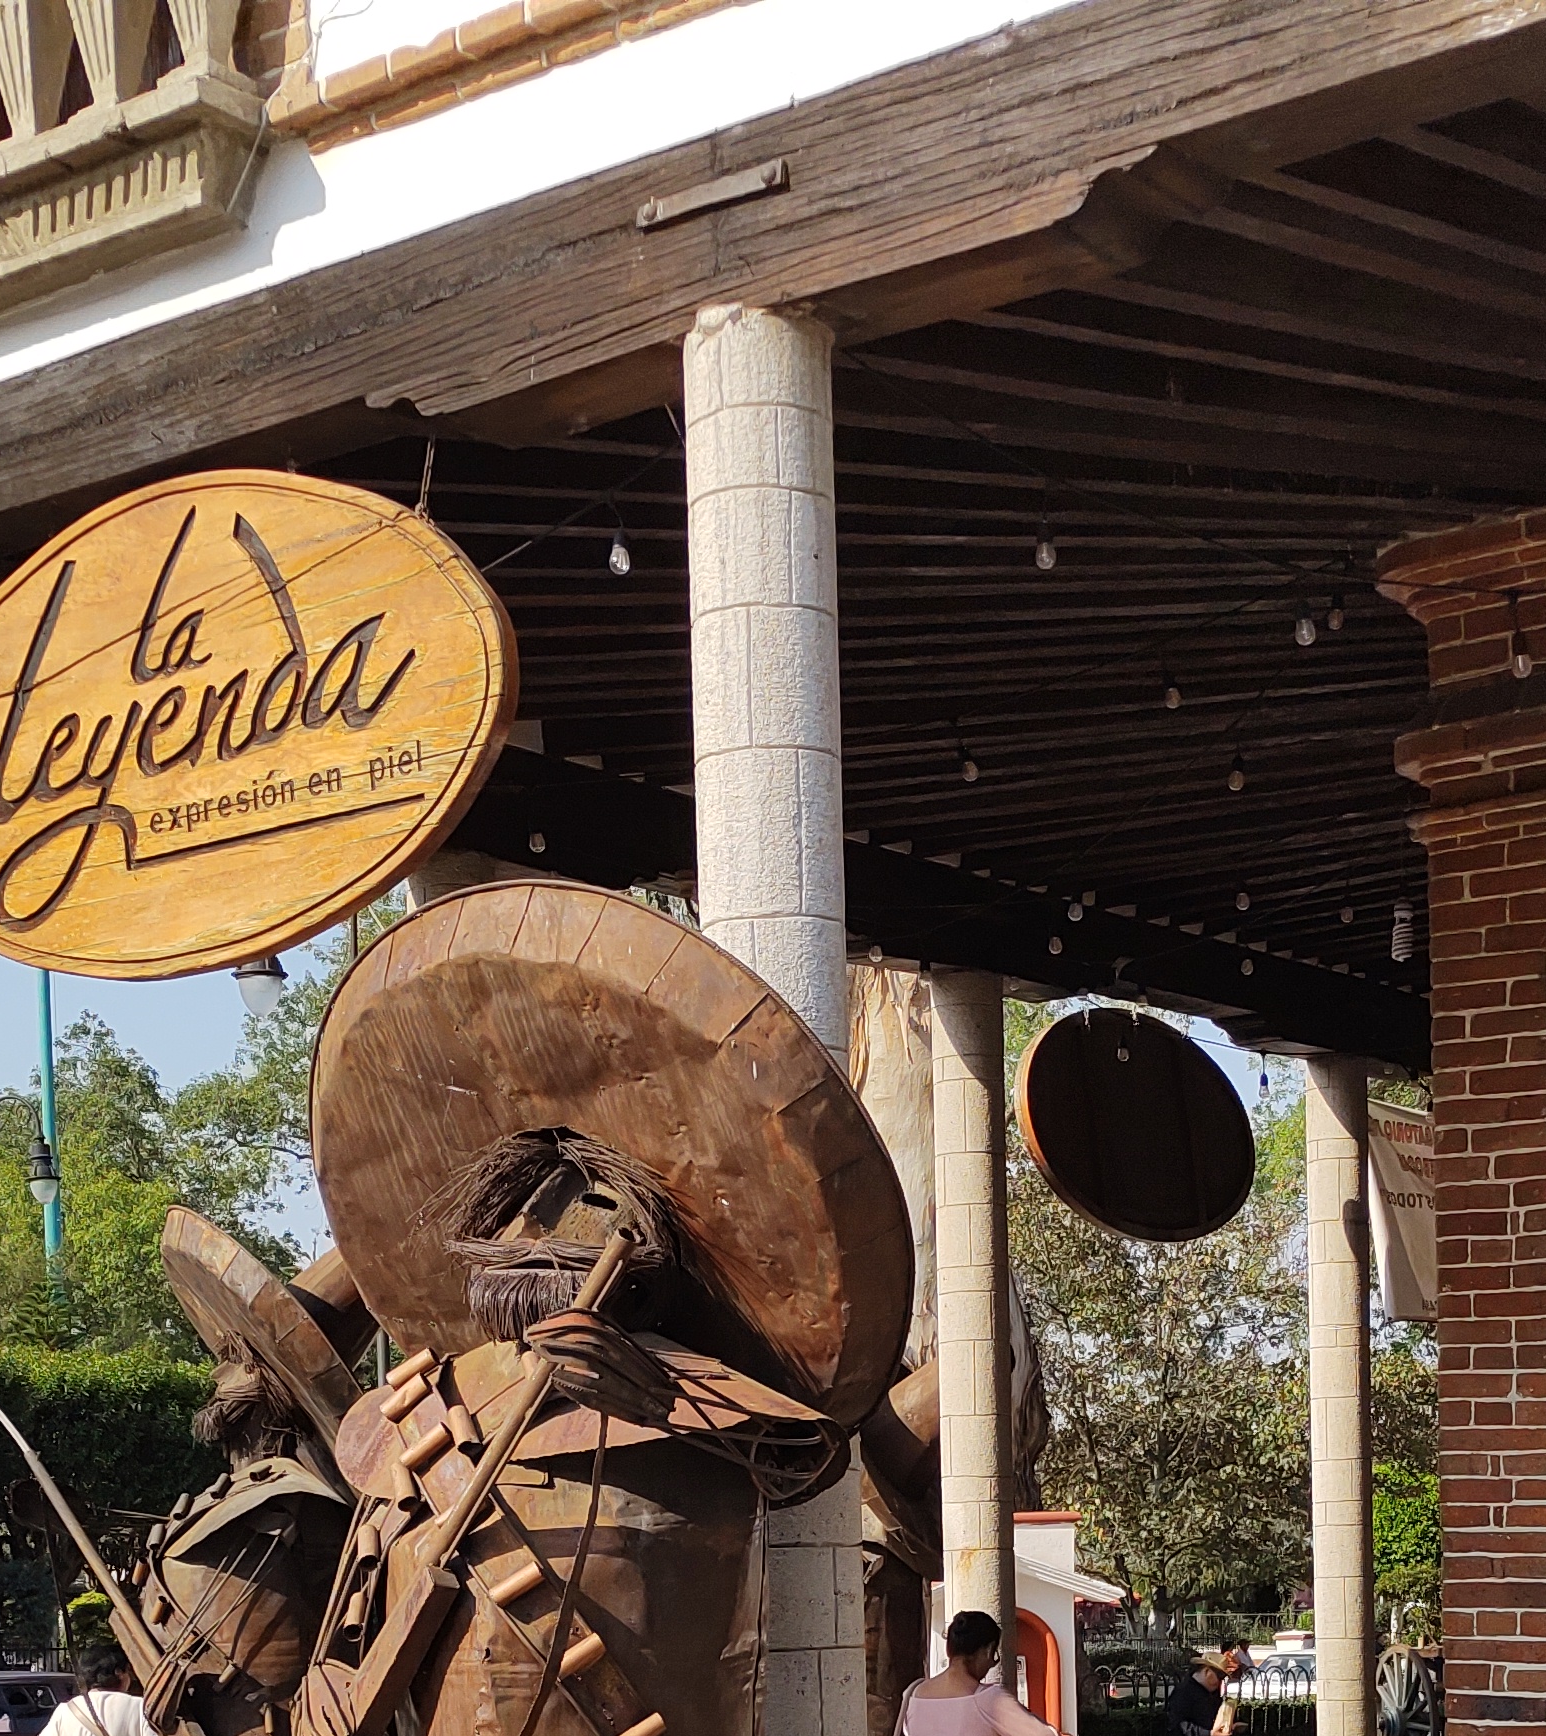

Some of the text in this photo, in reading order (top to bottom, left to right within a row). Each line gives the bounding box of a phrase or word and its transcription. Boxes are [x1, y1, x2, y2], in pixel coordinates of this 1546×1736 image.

[149, 739, 424, 834] expresión en piel
